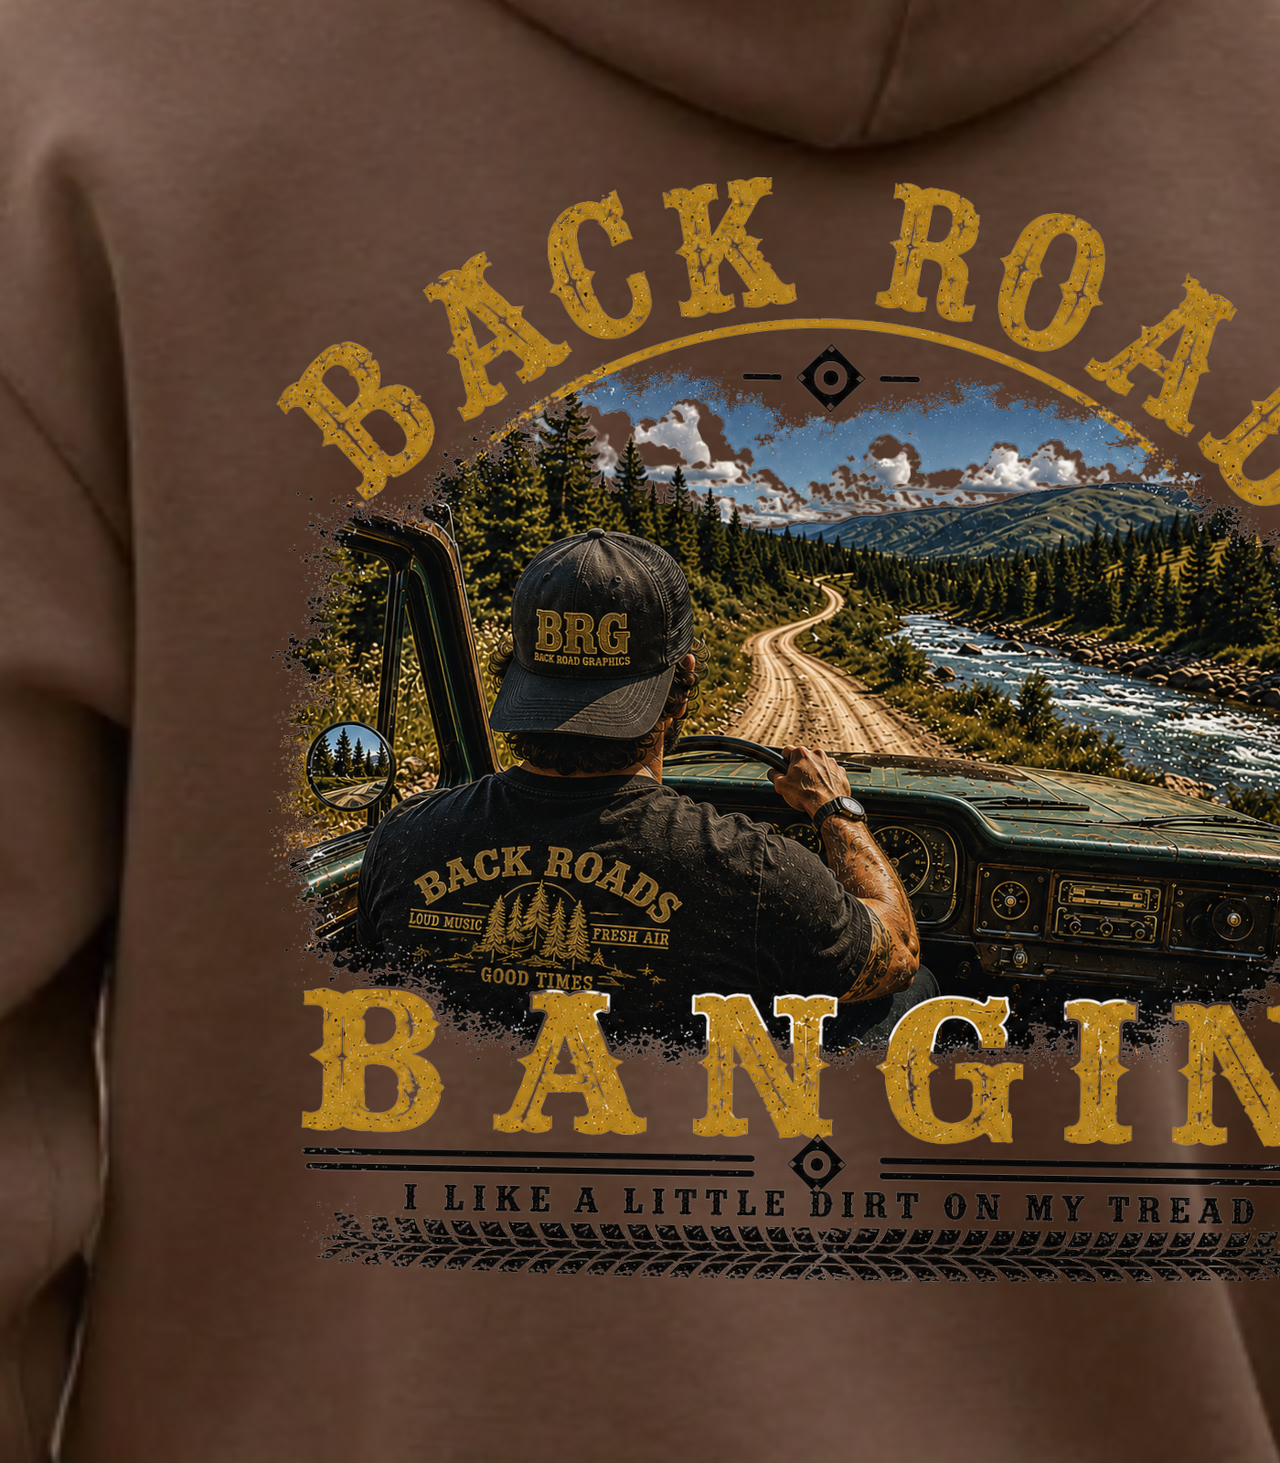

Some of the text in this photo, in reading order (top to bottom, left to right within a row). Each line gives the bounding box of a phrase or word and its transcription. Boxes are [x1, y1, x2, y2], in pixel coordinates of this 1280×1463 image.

[278, 176, 798, 501] BACK
[535, 608, 631, 655] BRG
[534, 651, 631, 667] BACK ROAD GRAPHICS
[414, 845, 683, 924] BACK ROADS
[408, 911, 483, 931] LOUD MUSIC
[593, 927, 669, 946] FRESH AIR
[480, 966, 593, 991] GOOD TIMES
[403, 1183, 1256, 1225] I LIKE A LITTLE DIRT ON MY TREAD
